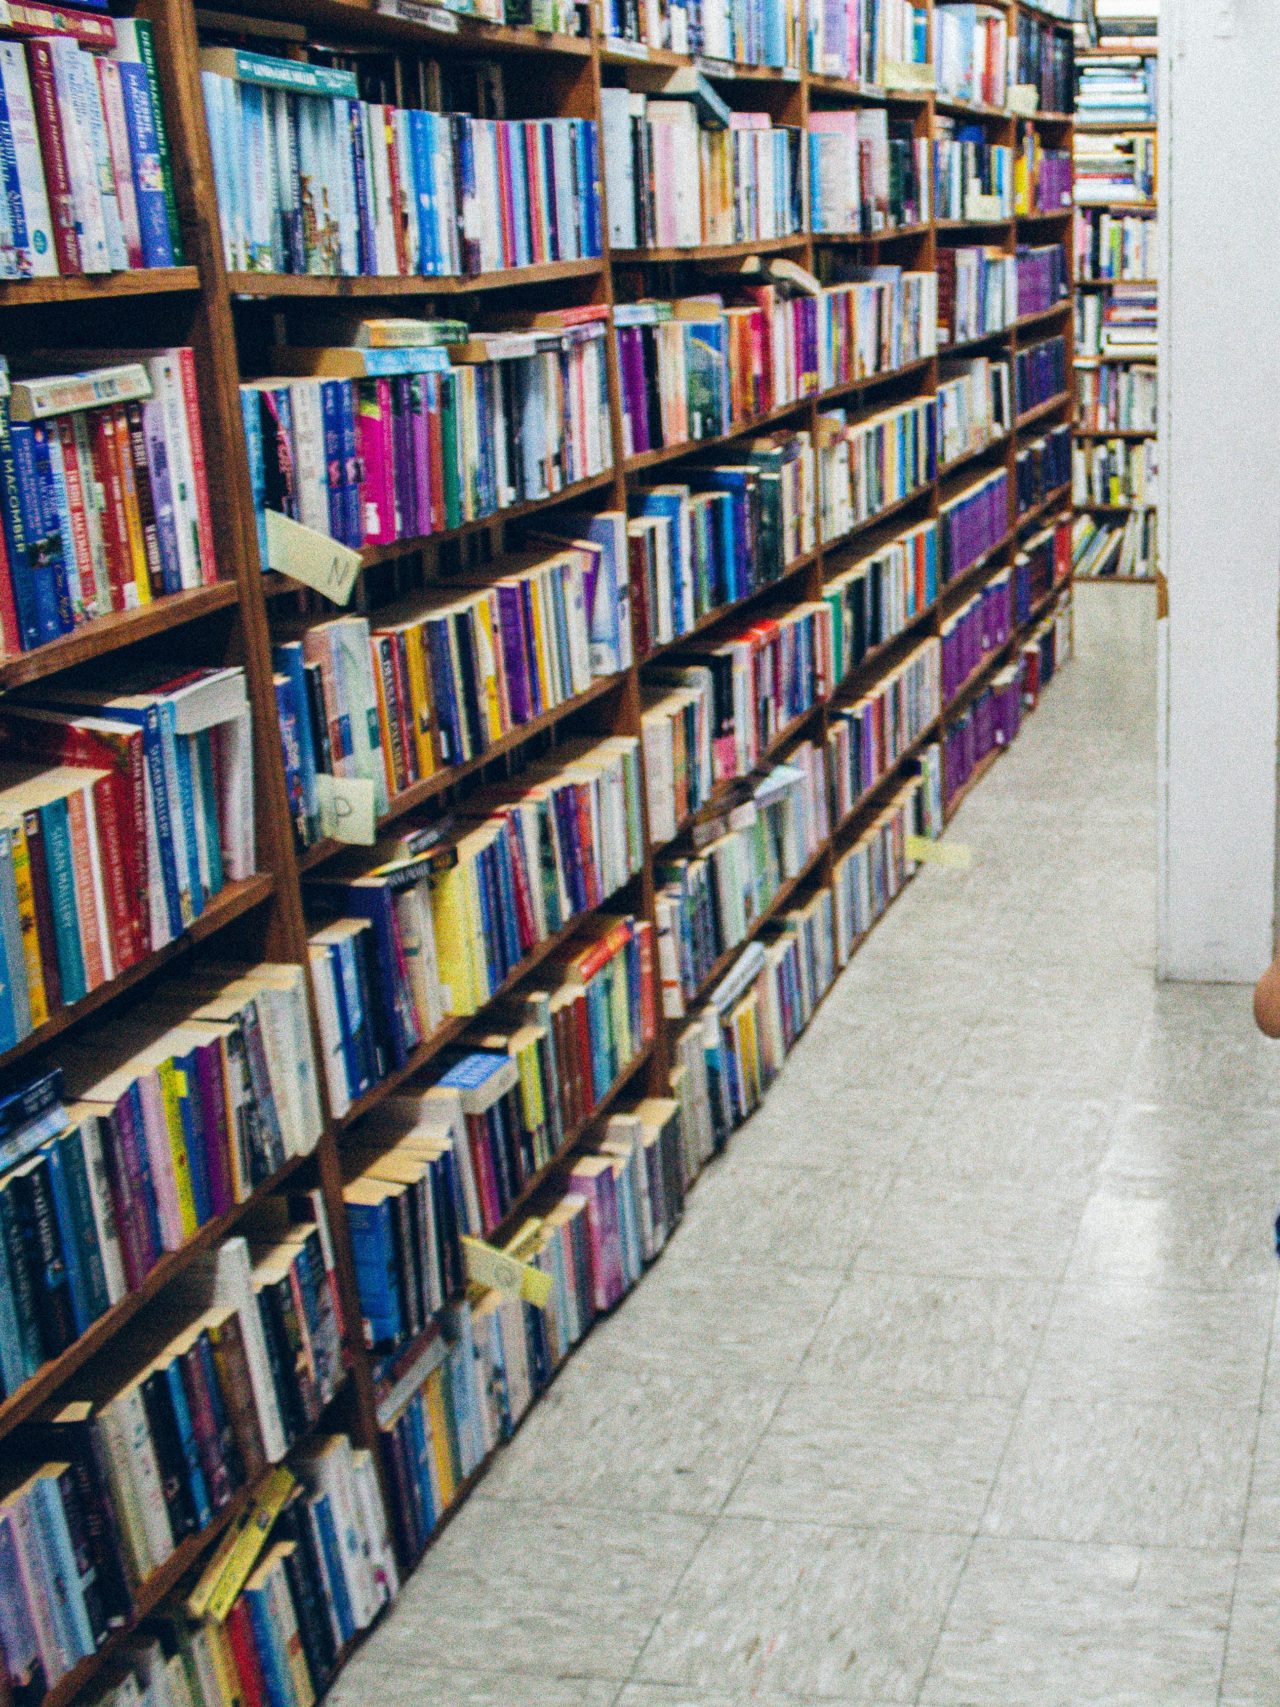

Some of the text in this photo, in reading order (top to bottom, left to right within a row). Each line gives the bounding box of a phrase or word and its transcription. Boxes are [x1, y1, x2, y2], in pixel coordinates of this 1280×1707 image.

[140, 30, 167, 157] DEBBIE MACOMBER
[132, 430, 148, 467] DEBBIE
[5, 458, 26, 554] MACOMBER
[66, 469, 90, 573] DEBBIE MACOMBER
[148, 744, 171, 839] SUSAN MALLERY
[51, 826, 73, 929] SUSAN MALLERY
